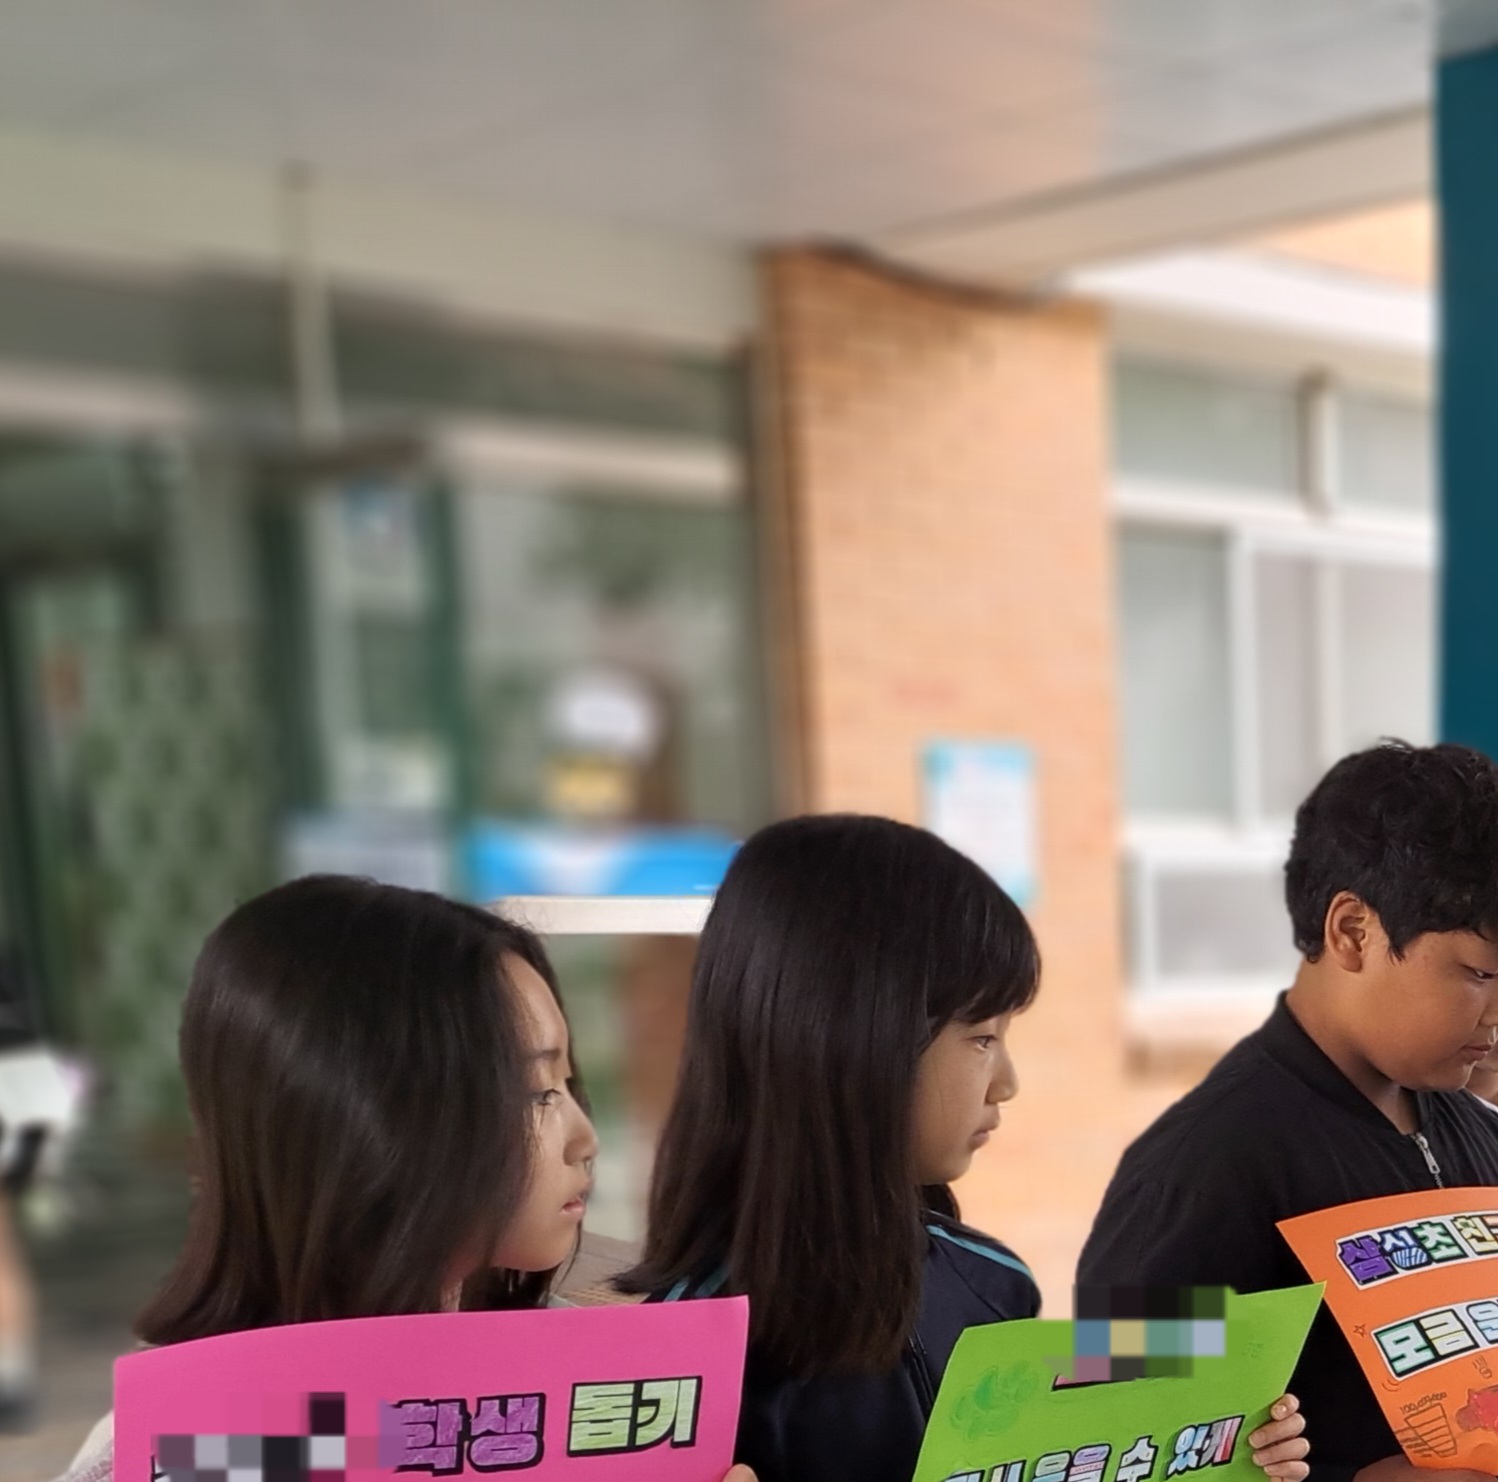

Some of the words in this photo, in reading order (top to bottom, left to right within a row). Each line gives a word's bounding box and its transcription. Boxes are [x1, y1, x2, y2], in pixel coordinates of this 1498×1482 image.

[1372, 1308, 1480, 1378] 모금
[386, 1392, 546, 1476] 학생
[567, 1376, 702, 1457] 돕기
[1165, 1415, 1246, 1478] 있게
